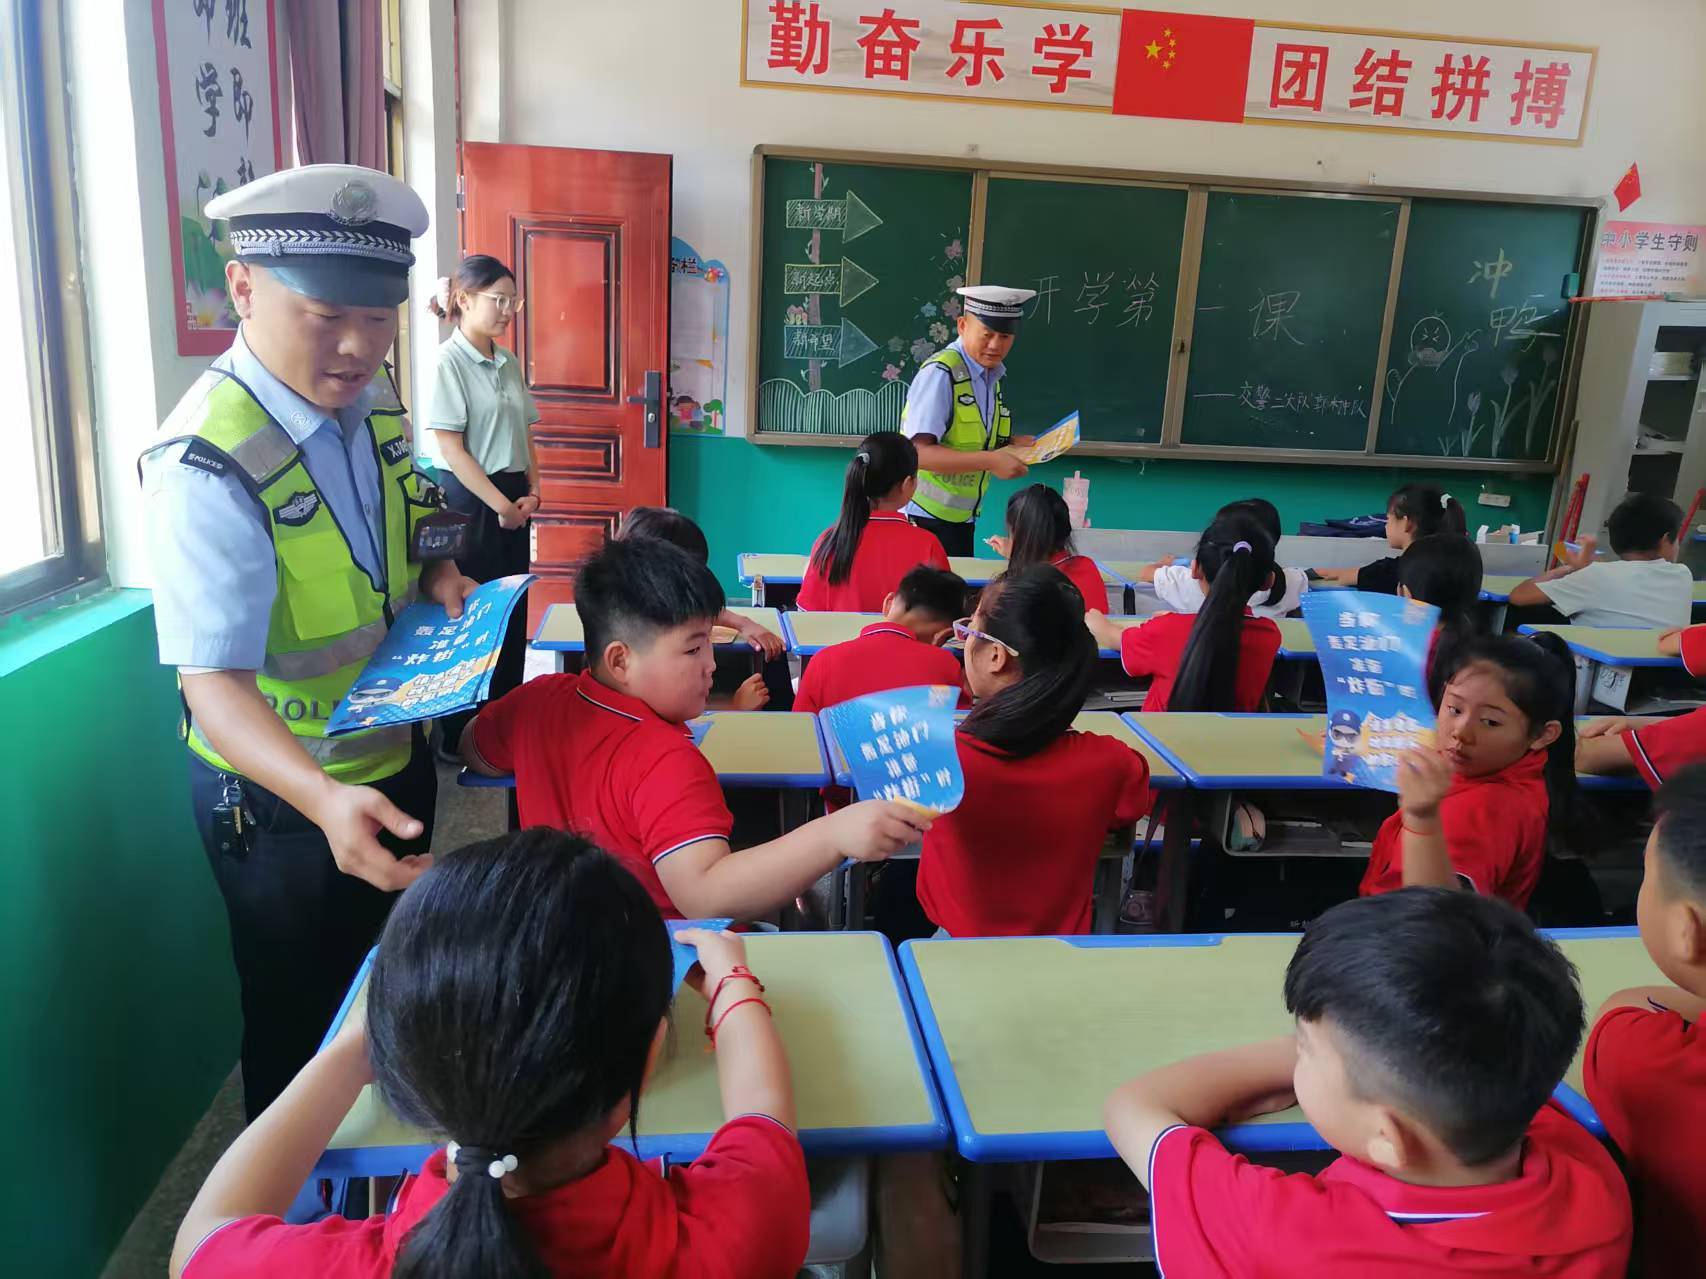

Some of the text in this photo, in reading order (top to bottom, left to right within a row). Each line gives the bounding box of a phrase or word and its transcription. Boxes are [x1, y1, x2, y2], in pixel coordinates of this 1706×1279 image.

[767, 1, 1095, 95] 勤奋乐学
[1268, 42, 1573, 128] 团结拼搏
[797, 204, 841, 223] 新学期
[1601, 231, 1699, 252] 中小学生守则
[1466, 247, 1513, 299] 冲
